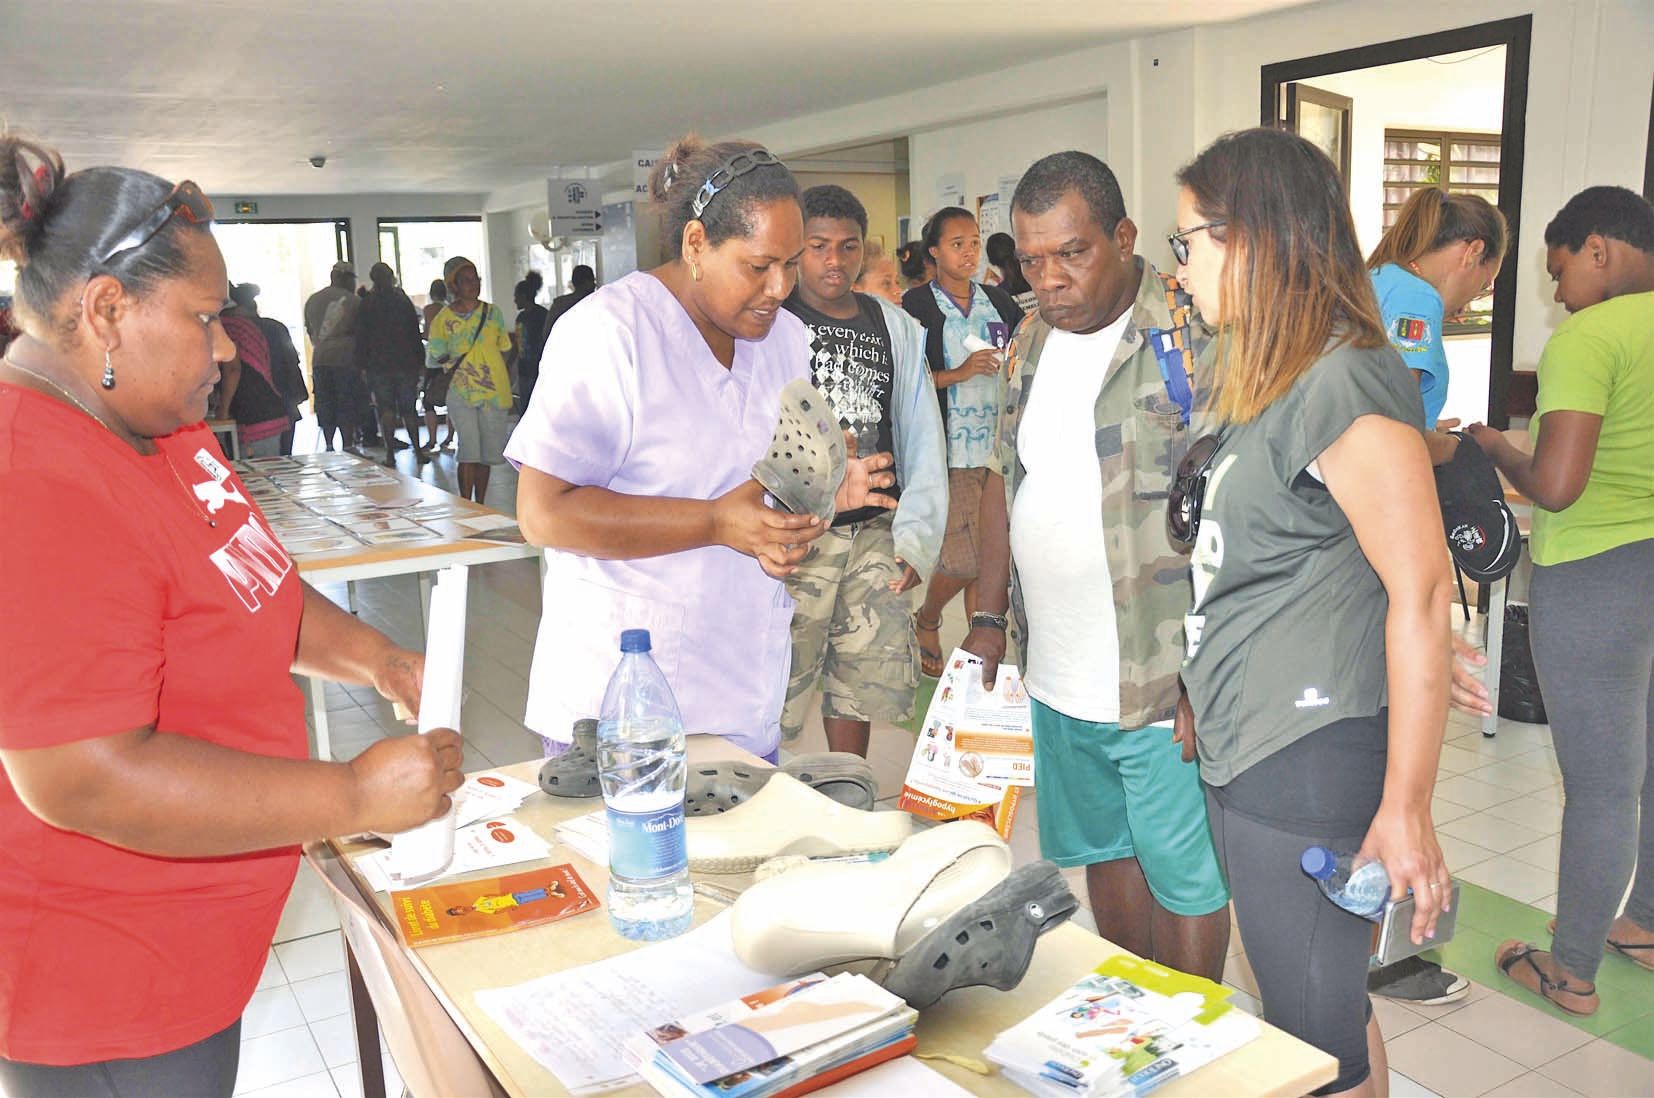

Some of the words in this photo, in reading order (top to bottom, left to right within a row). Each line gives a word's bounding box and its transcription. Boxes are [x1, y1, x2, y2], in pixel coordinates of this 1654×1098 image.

[817, 325, 858, 342] every
[835, 342, 880, 363] which
[848, 363, 890, 383] comes
[1012, 762, 1031, 772] PIED
